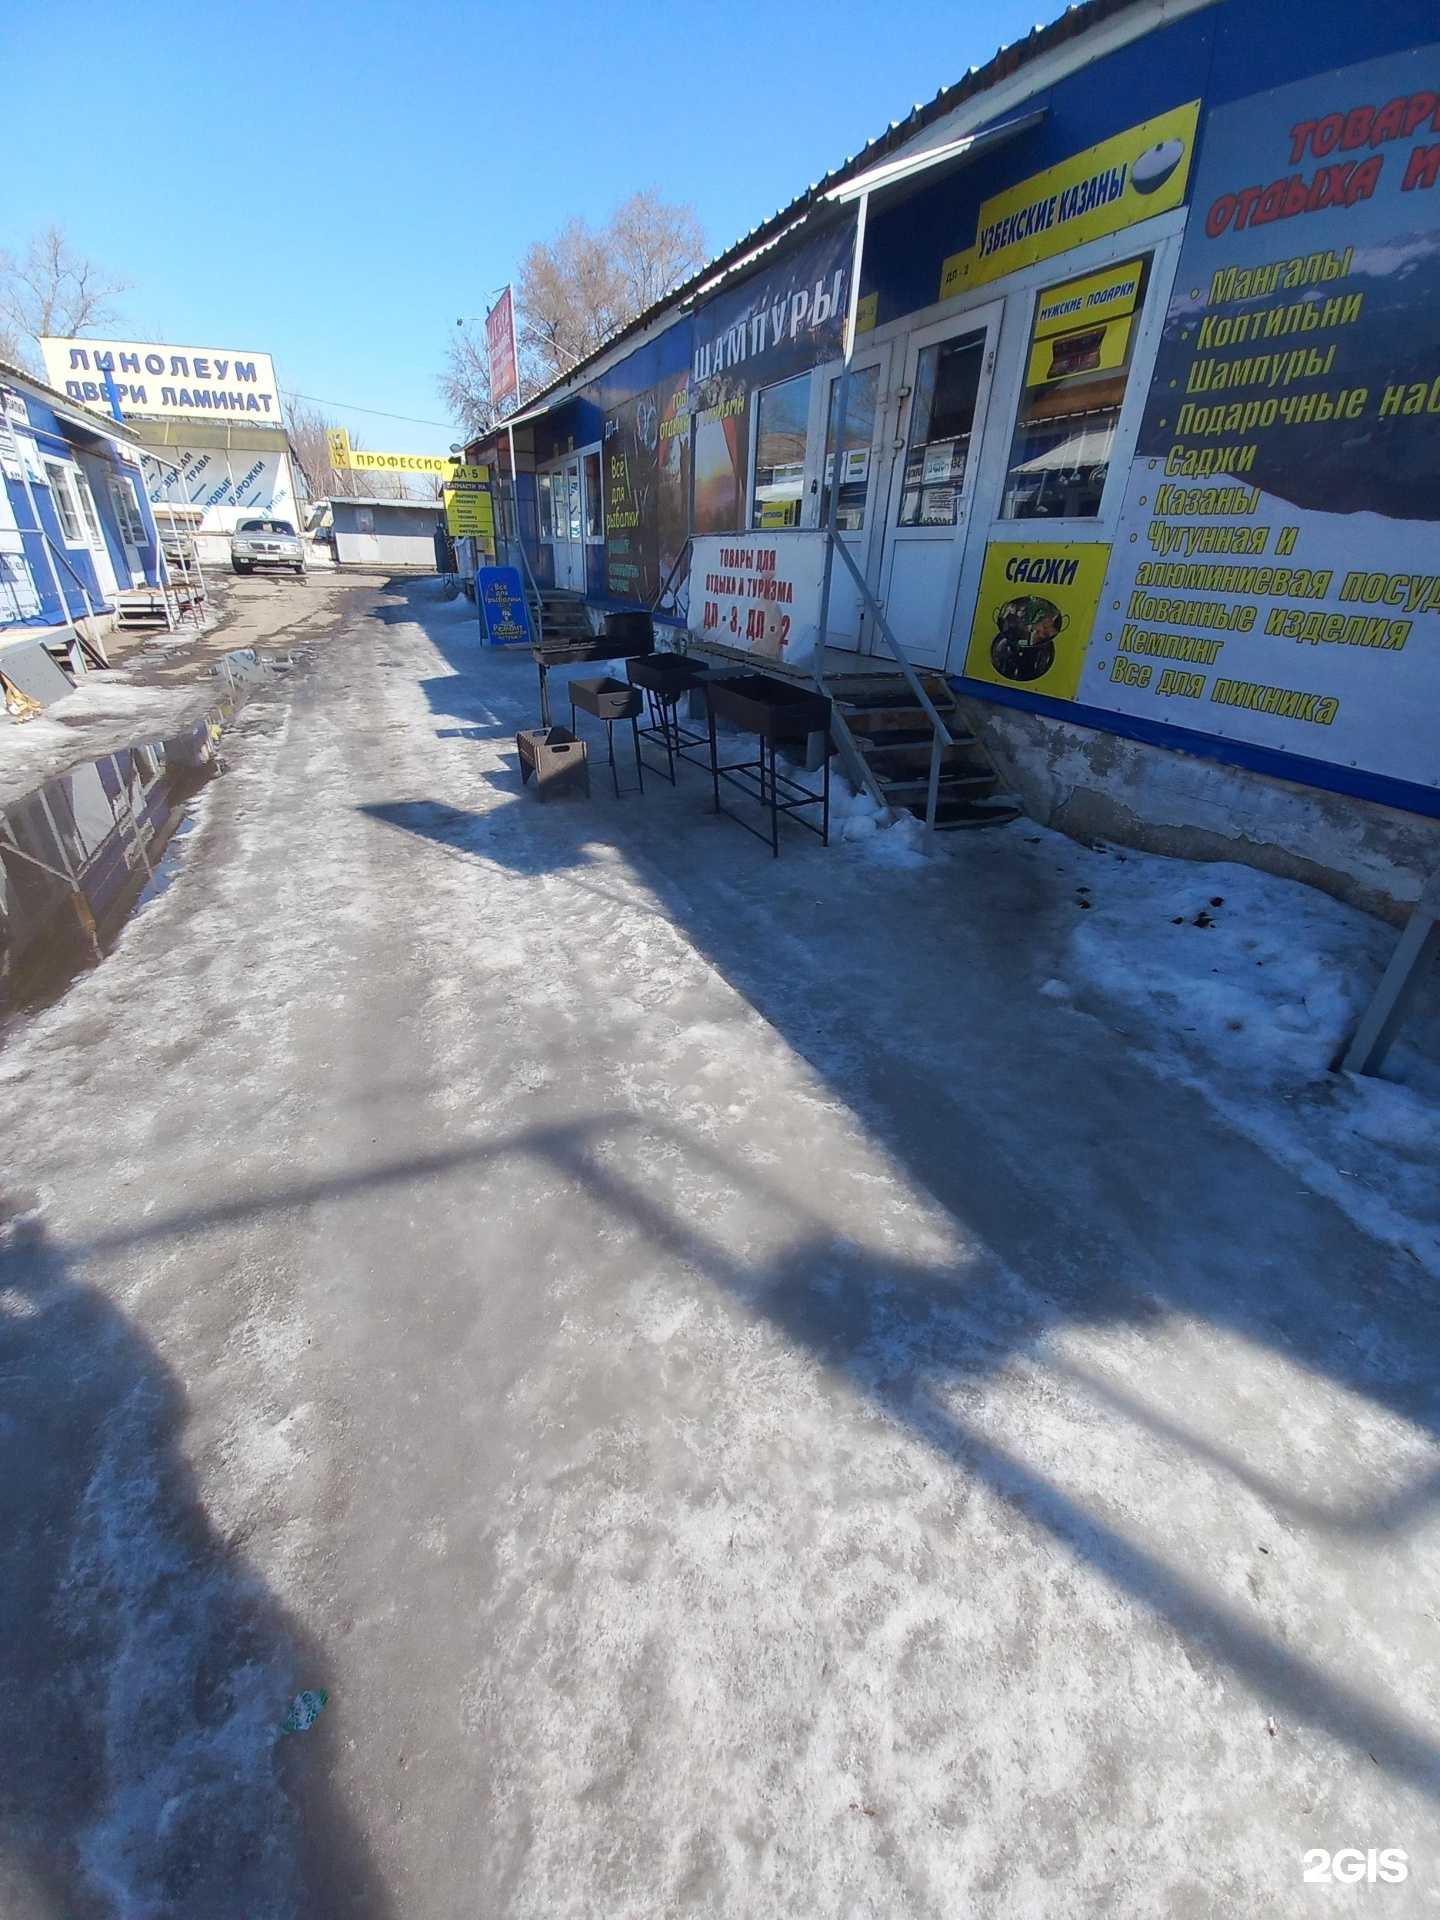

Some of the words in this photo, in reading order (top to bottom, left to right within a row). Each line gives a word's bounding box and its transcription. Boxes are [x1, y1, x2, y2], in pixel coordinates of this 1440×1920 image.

[1288, 91, 1440, 166] ТОВАР
[979, 195, 1058, 259] УЗБЕКСКИЕ
[1057, 162, 1128, 224] КАЗАНЫ
[1204, 153, 1384, 239] ОТДЫХА
[1207, 246, 1355, 306] Мангалы
[1040, 297, 1082, 320] МУЖСКИЕ
[1087, 281, 1136, 306] ПОДАРКИ
[694, 268, 843, 384] ШАМПУРЫ
[1196, 292, 1364, 351] Коптильни
[69, 348, 258, 383] ЛИНОЛЕУМ
[1185, 344, 1337, 394] Шампуры
[161, 386, 274, 413] ЛАМИНАТ
[1174, 386, 1369, 437] Подарочные
[186, 454, 212, 482] ТРАВА
[356, 454, 448, 470] ПРОФЕССИО
[1164, 443, 1258, 478] Саджи
[1153, 483, 1262, 517] Казаны
[1147, 520, 1270, 557] Чугунная
[1274, 526, 1300, 556] и
[719, 548, 753, 569] ТОВАРЫ
[755, 550, 777, 573] ДЛЯ
[1005, 557, 1080, 586] САДЖИ
[706, 573, 737, 596] ОТДЫХА
[738, 577, 744, 597] И
[747, 578, 793, 604] ТУРИЗМА
[1135, 561, 1334, 600] алюминиевая
[779, 615, 791, 646] 2
[1126, 590, 1258, 633] Кованные
[1264, 608, 1414, 651] изделия
[1118, 623, 1225, 666] Кемпинг
[1110, 655, 1153, 687] Все
[1155, 669, 1206, 699] для
[1210, 678, 1340, 725] пикника
